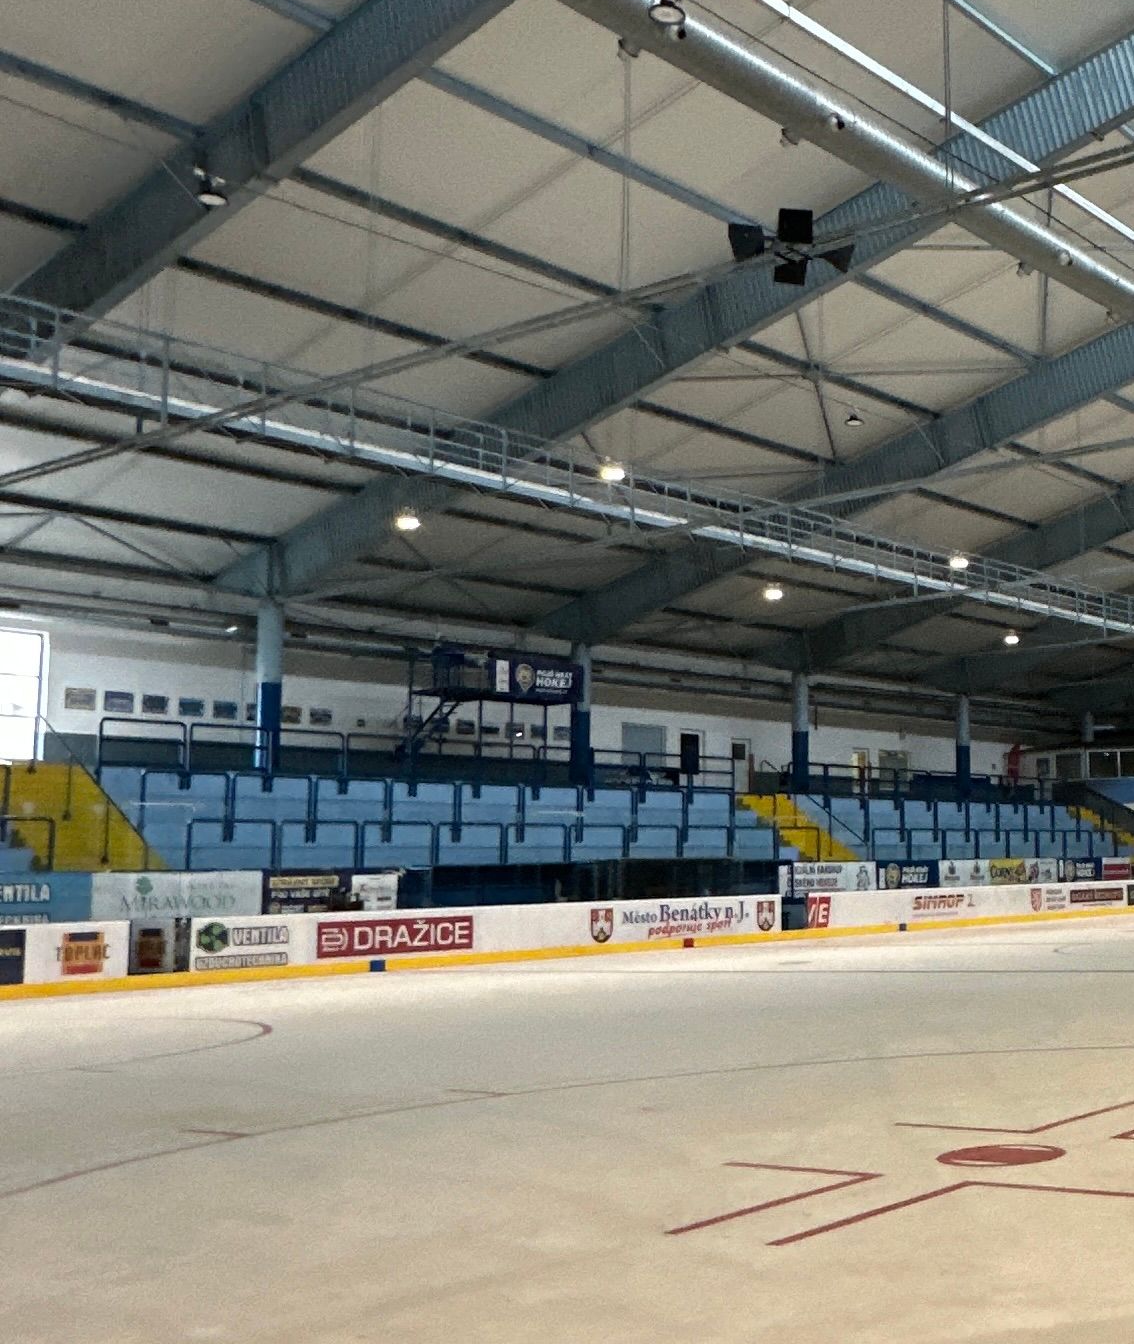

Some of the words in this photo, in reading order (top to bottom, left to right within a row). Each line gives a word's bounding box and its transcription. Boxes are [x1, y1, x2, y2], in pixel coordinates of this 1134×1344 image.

[0, 883, 50, 903] NTILA
[622, 910, 658, 924] Město
[659, 901, 722, 921] Benátky
[232, 926, 289, 946] VENTILA
[353, 919, 471, 951] DRAŽICE
